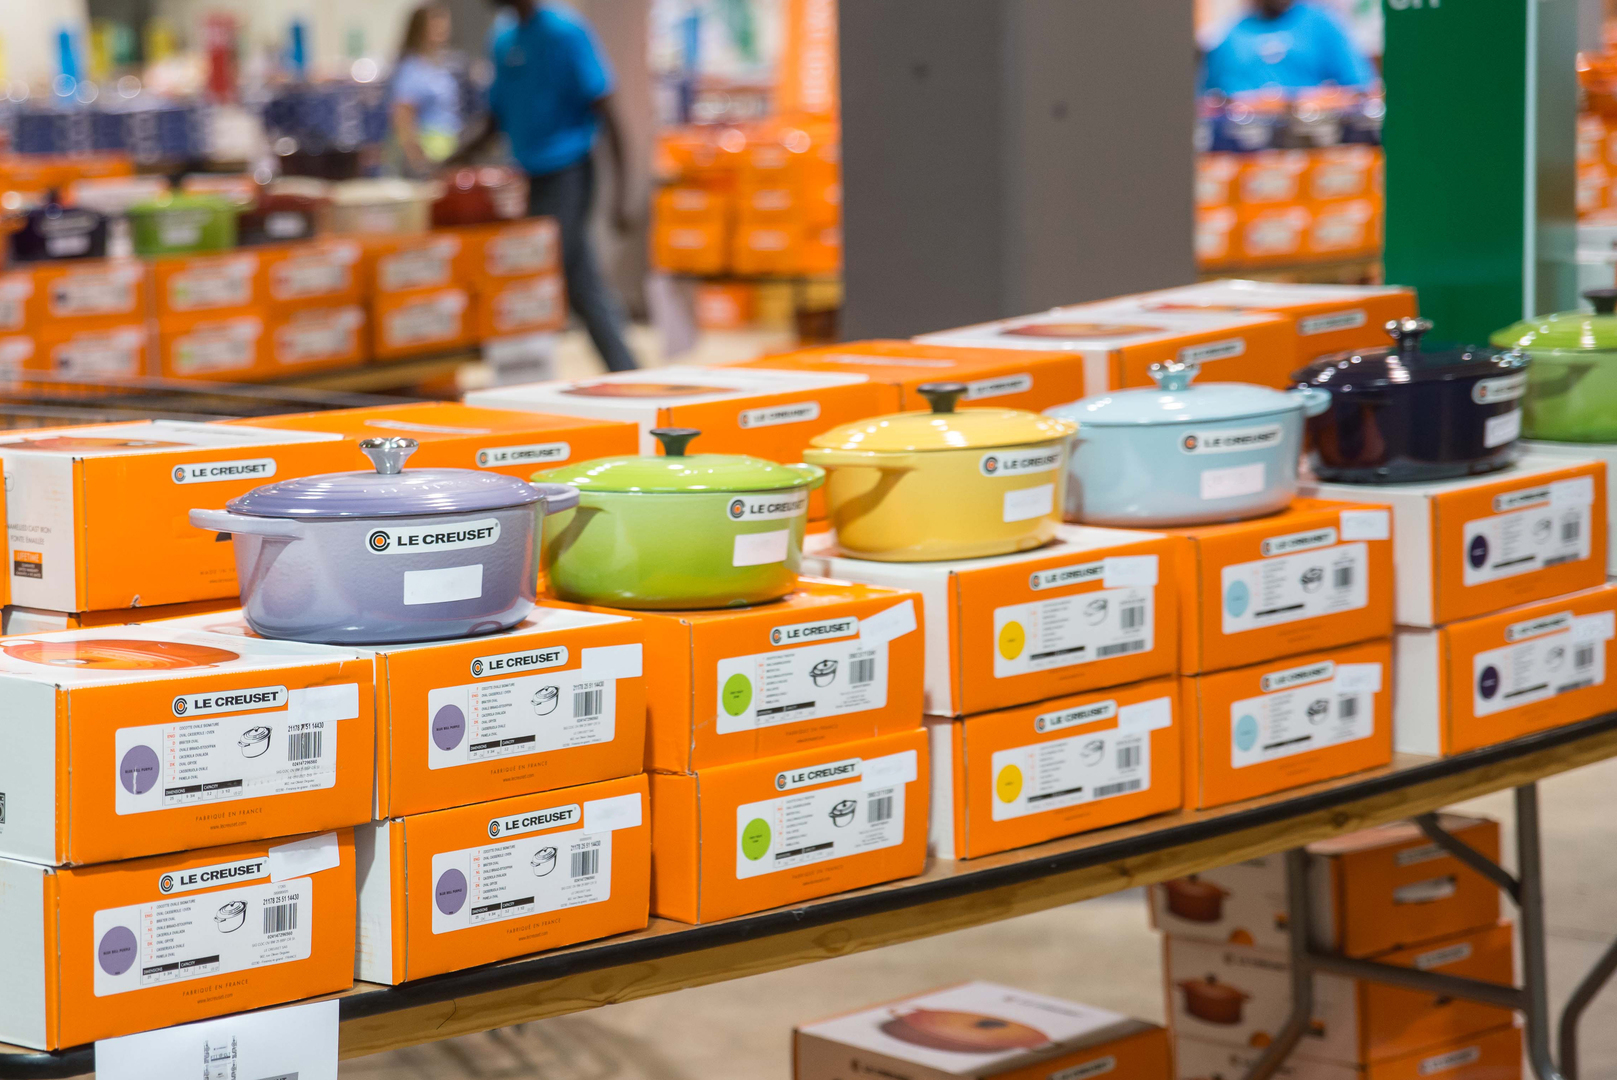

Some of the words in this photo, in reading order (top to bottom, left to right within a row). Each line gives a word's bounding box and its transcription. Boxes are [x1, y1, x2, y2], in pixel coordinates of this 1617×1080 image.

[494, 453, 508, 461] LE
[511, 448, 561, 459] CREUSET
[193, 469, 207, 477] LE
[210, 464, 267, 476] CREUSET
[1004, 460, 1017, 469] LE
[750, 505, 764, 514] LE
[398, 535, 419, 546] LE
[422, 527, 494, 544] CREUSET
[1045, 574, 1057, 583] LE
[787, 629, 800, 639] LE
[802, 622, 851, 636] CREUSET
[489, 660, 503, 670] LE
[506, 652, 560, 668] CREUSET
[194, 698, 212, 710] LE
[215, 692, 279, 707] CREUSET
[288, 724, 299, 732] 21178
[312, 721, 324, 729] 14430
[1050, 716, 1061, 726] LE
[792, 773, 805, 784] LE
[807, 764, 856, 780] CREUSET
[506, 820, 519, 831] LE
[522, 810, 573, 828] CREUSET
[180, 874, 197, 886] LE
[200, 863, 263, 881] CREUSET
[263, 896, 275, 905] 21178
[226, 979, 249, 988] FRANCE
